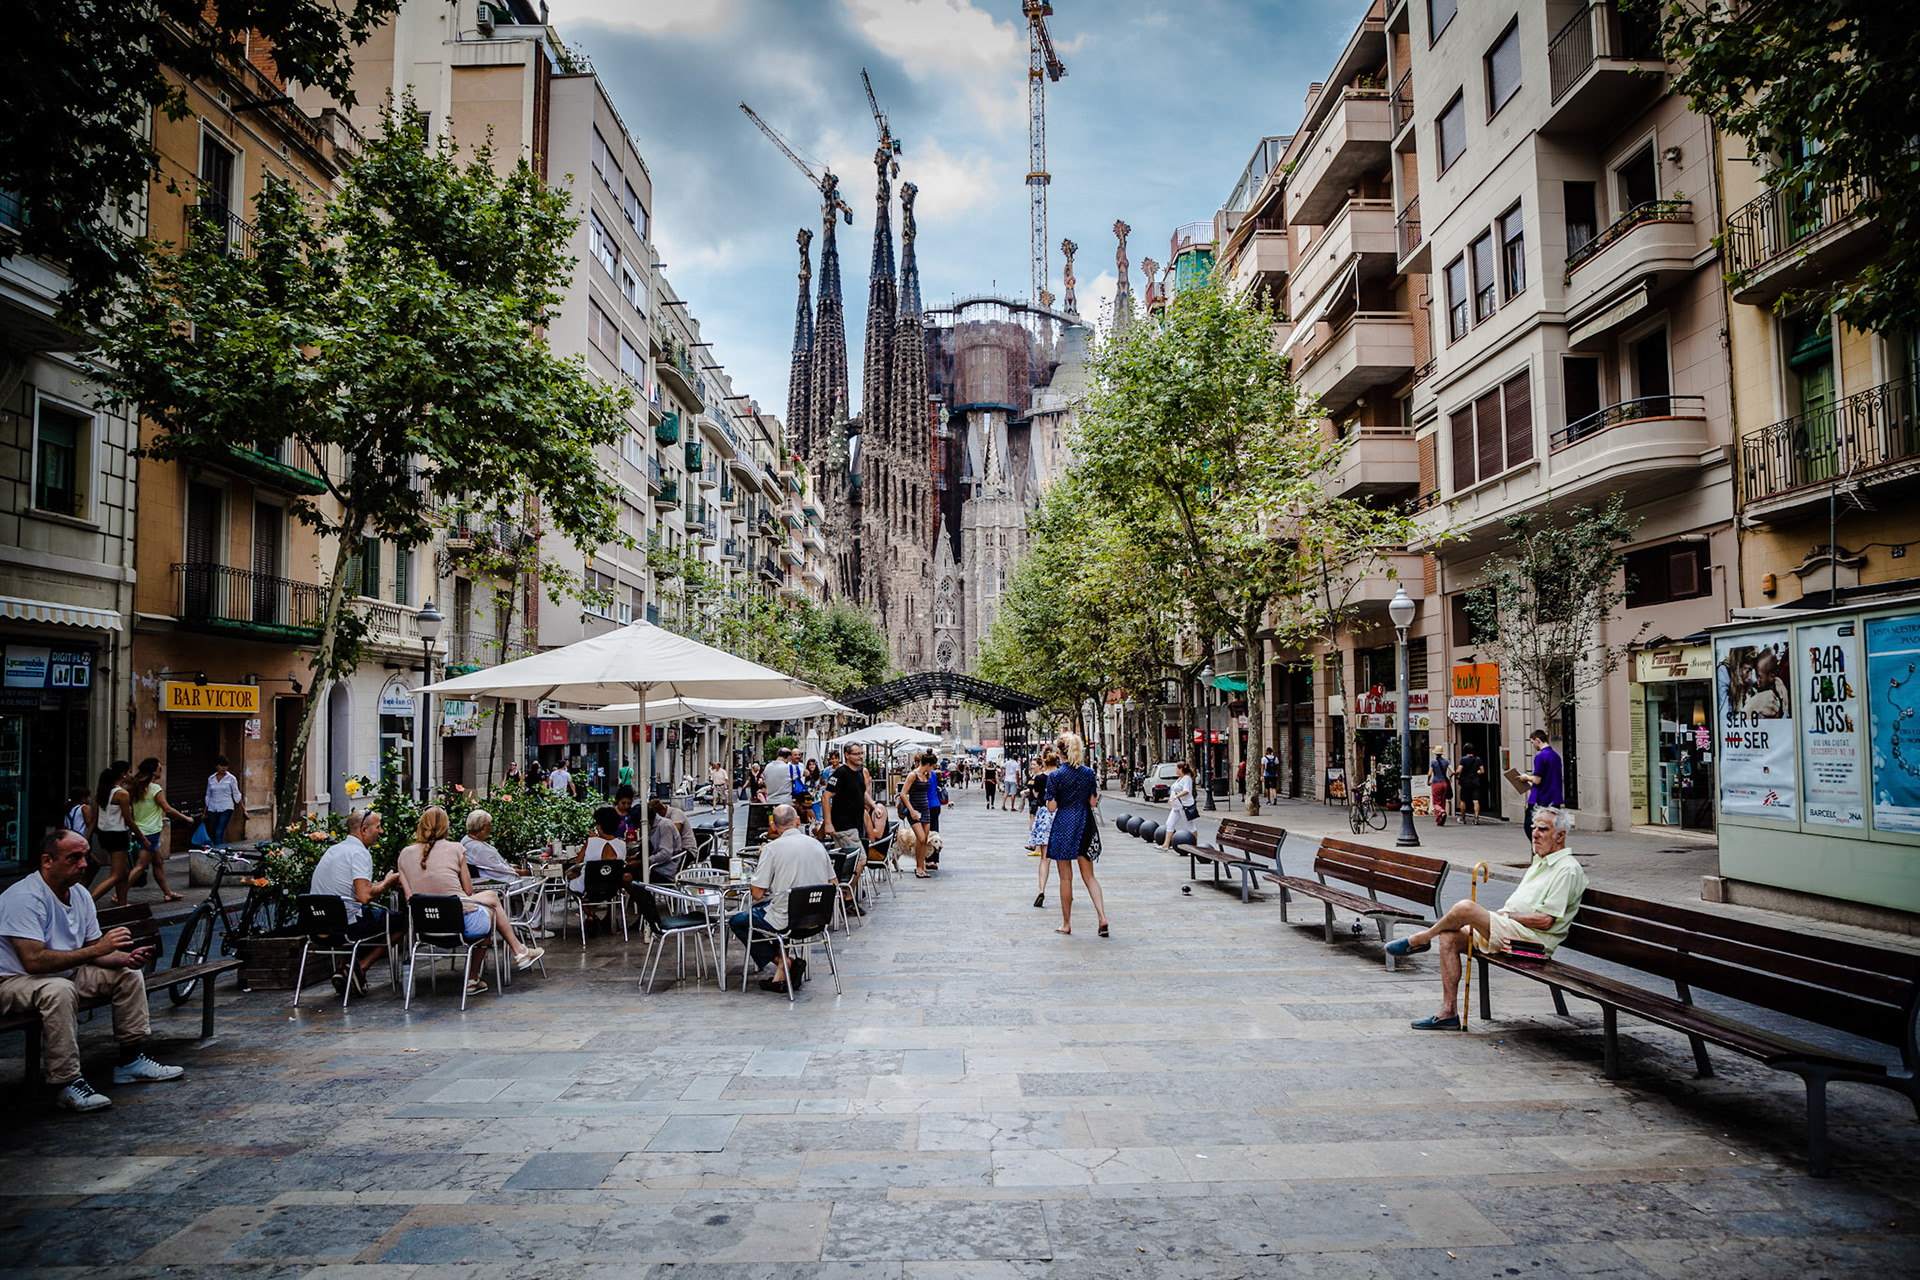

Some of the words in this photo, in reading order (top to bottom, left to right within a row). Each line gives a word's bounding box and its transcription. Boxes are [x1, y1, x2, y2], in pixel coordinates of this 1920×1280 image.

[1456, 672, 1480, 692] kuky
[173, 687, 201, 706] BAR
[204, 689, 253, 708] VICTOR
[1450, 711, 1459, 722] DE
[1726, 711, 1748, 729] SER
[1816, 704, 1845, 733] N3S
[1726, 731, 1741, 749] NO
[1744, 731, 1769, 750] SER
